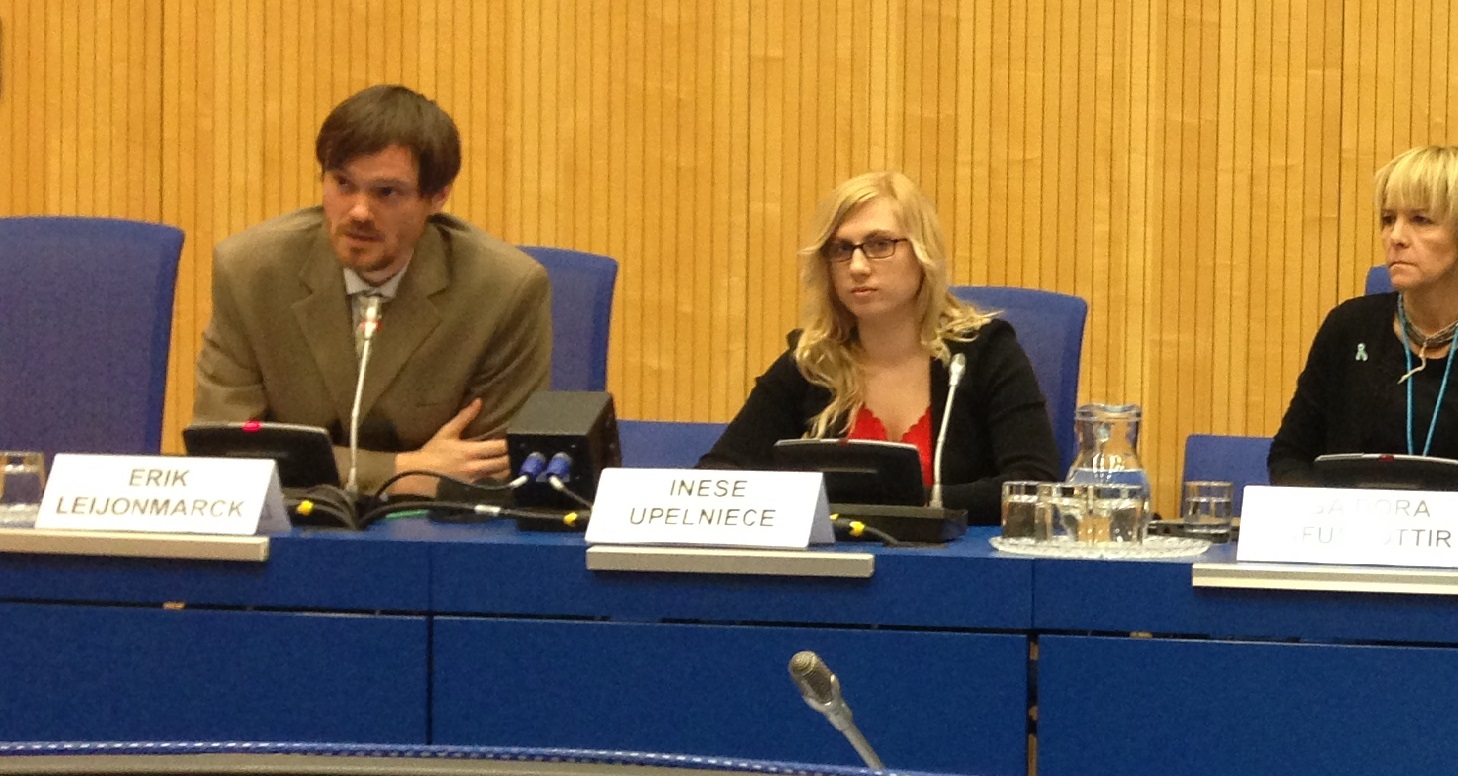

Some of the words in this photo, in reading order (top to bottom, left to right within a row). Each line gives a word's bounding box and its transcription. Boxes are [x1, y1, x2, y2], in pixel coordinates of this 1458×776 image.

[129, 468, 190, 487] ERIK
[669, 479, 748, 498] INESE
[55, 496, 245, 517] LEIJONMARCK
[629, 507, 776, 527] UPELNIECE
